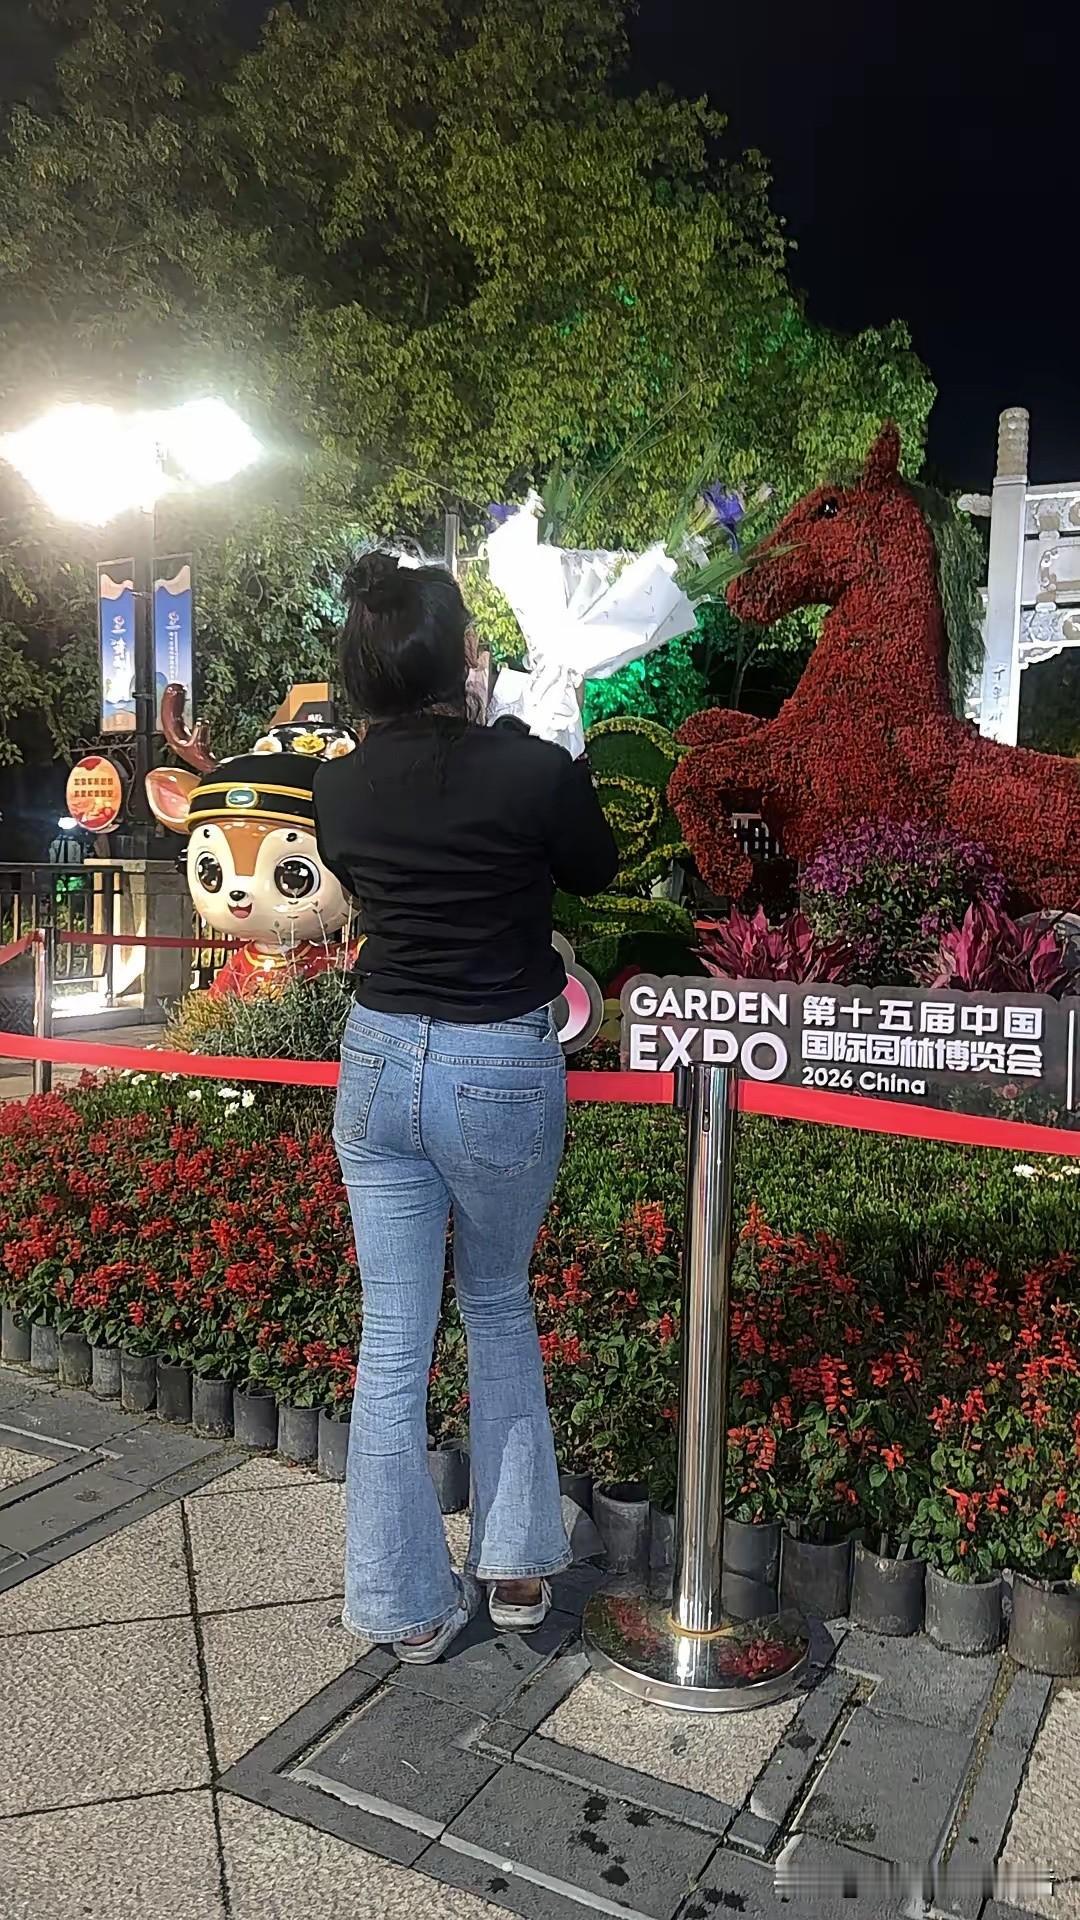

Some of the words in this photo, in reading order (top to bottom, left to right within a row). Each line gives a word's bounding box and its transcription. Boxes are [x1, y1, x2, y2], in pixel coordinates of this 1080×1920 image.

[630, 986, 787, 1025] GARDEN
[802, 995, 1042, 1040] 第十五届中国
[629, 1024, 788, 1080] EXPO
[801, 1031, 1042, 1078] 国际园林博览会
[801, 1066, 853, 1089] 2026
[859, 1071, 926, 1095] China
